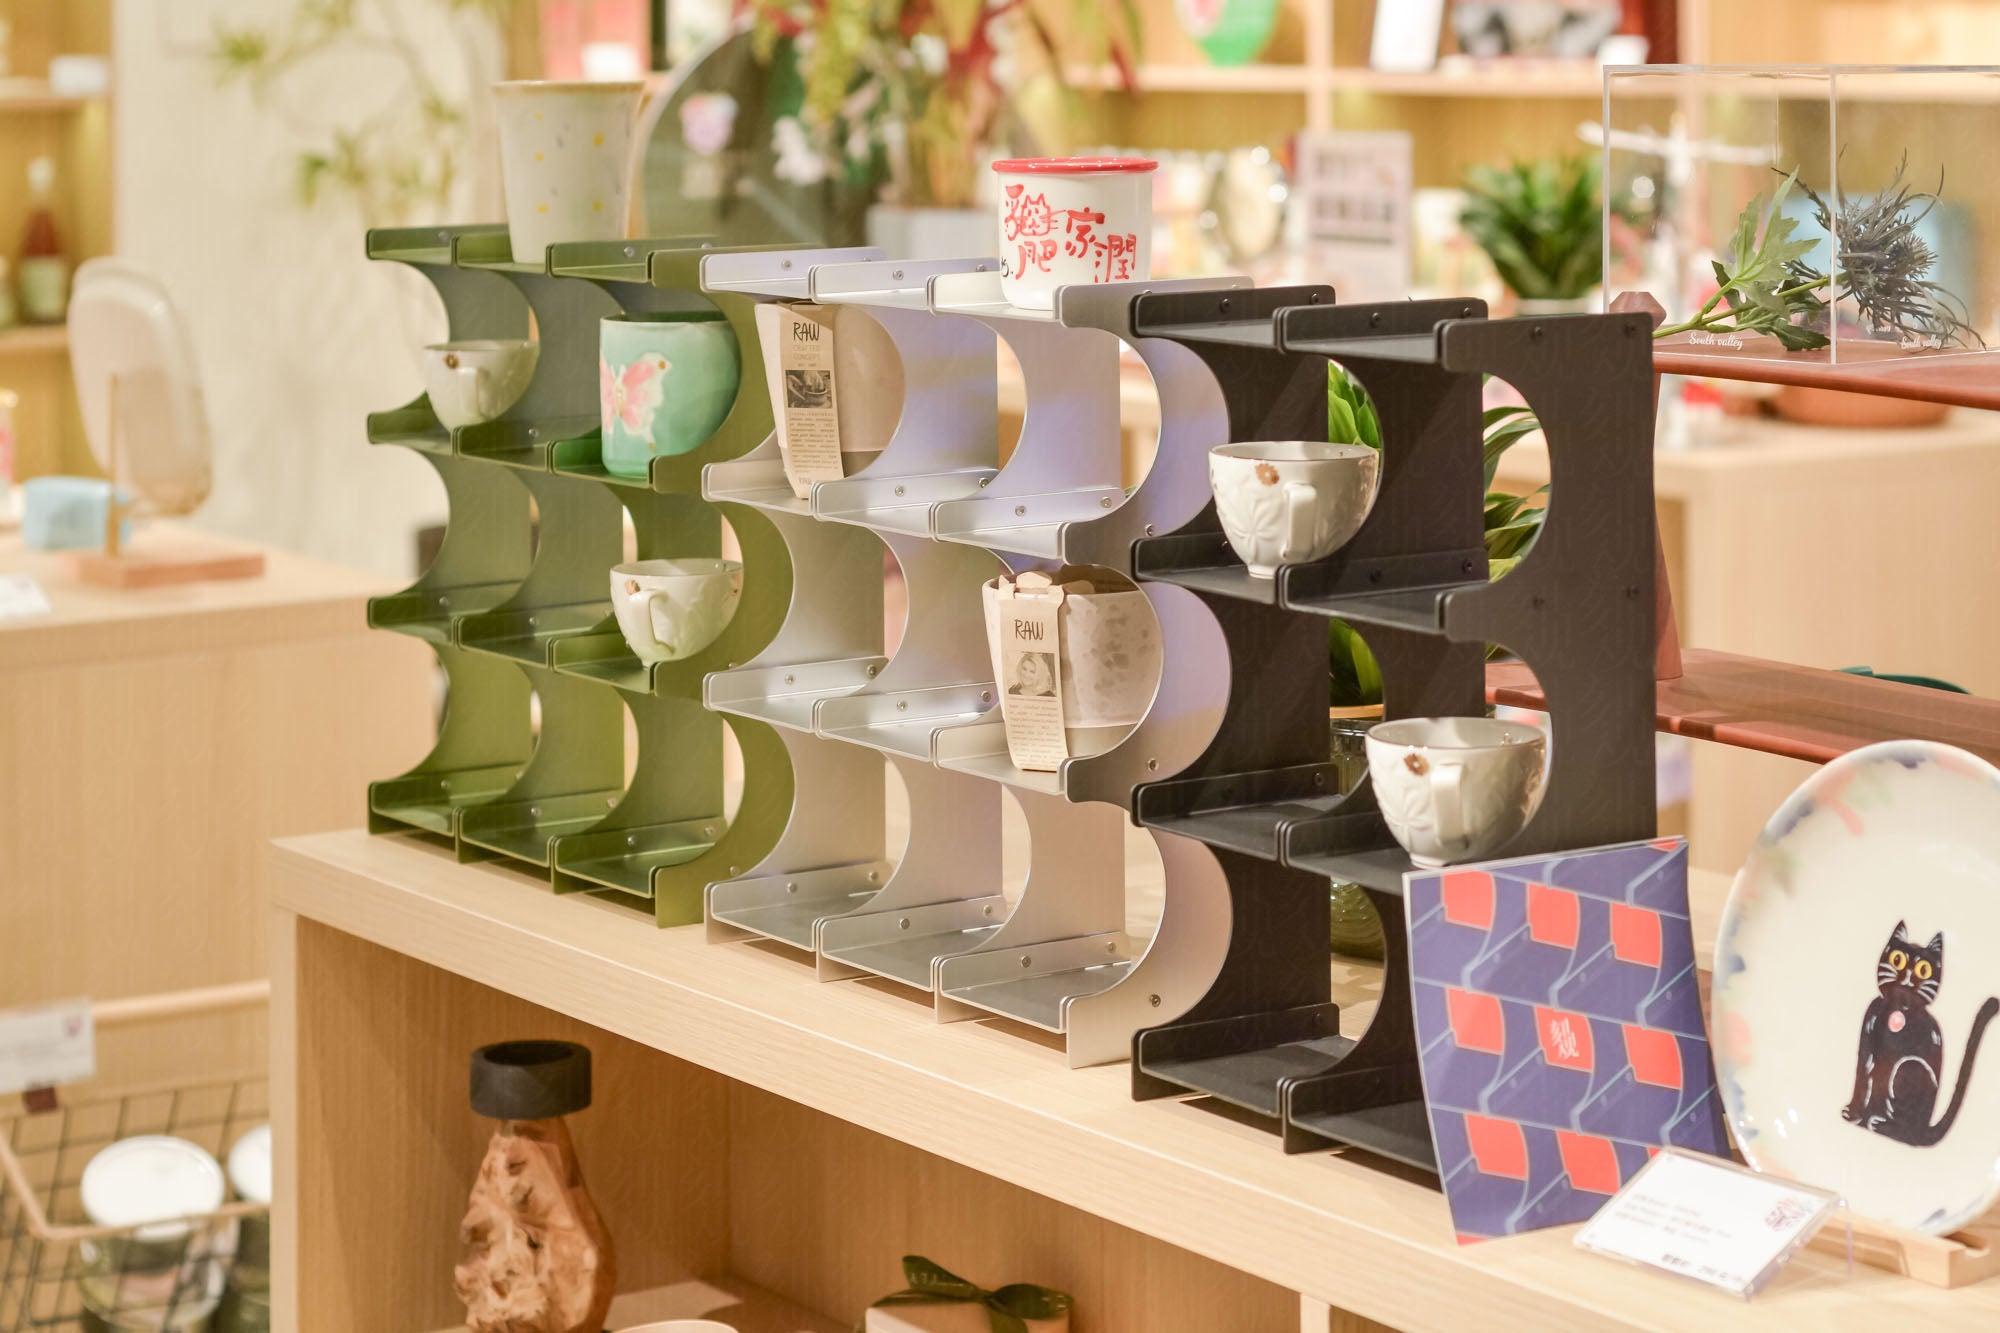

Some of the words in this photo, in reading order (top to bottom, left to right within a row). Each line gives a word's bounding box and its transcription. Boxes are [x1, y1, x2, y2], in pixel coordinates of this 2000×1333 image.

[793, 322, 820, 342] RAW
[1689, 331, 1714, 346] South
[1717, 334, 1743, 351] valley
[1014, 619, 1044, 640] RAW
